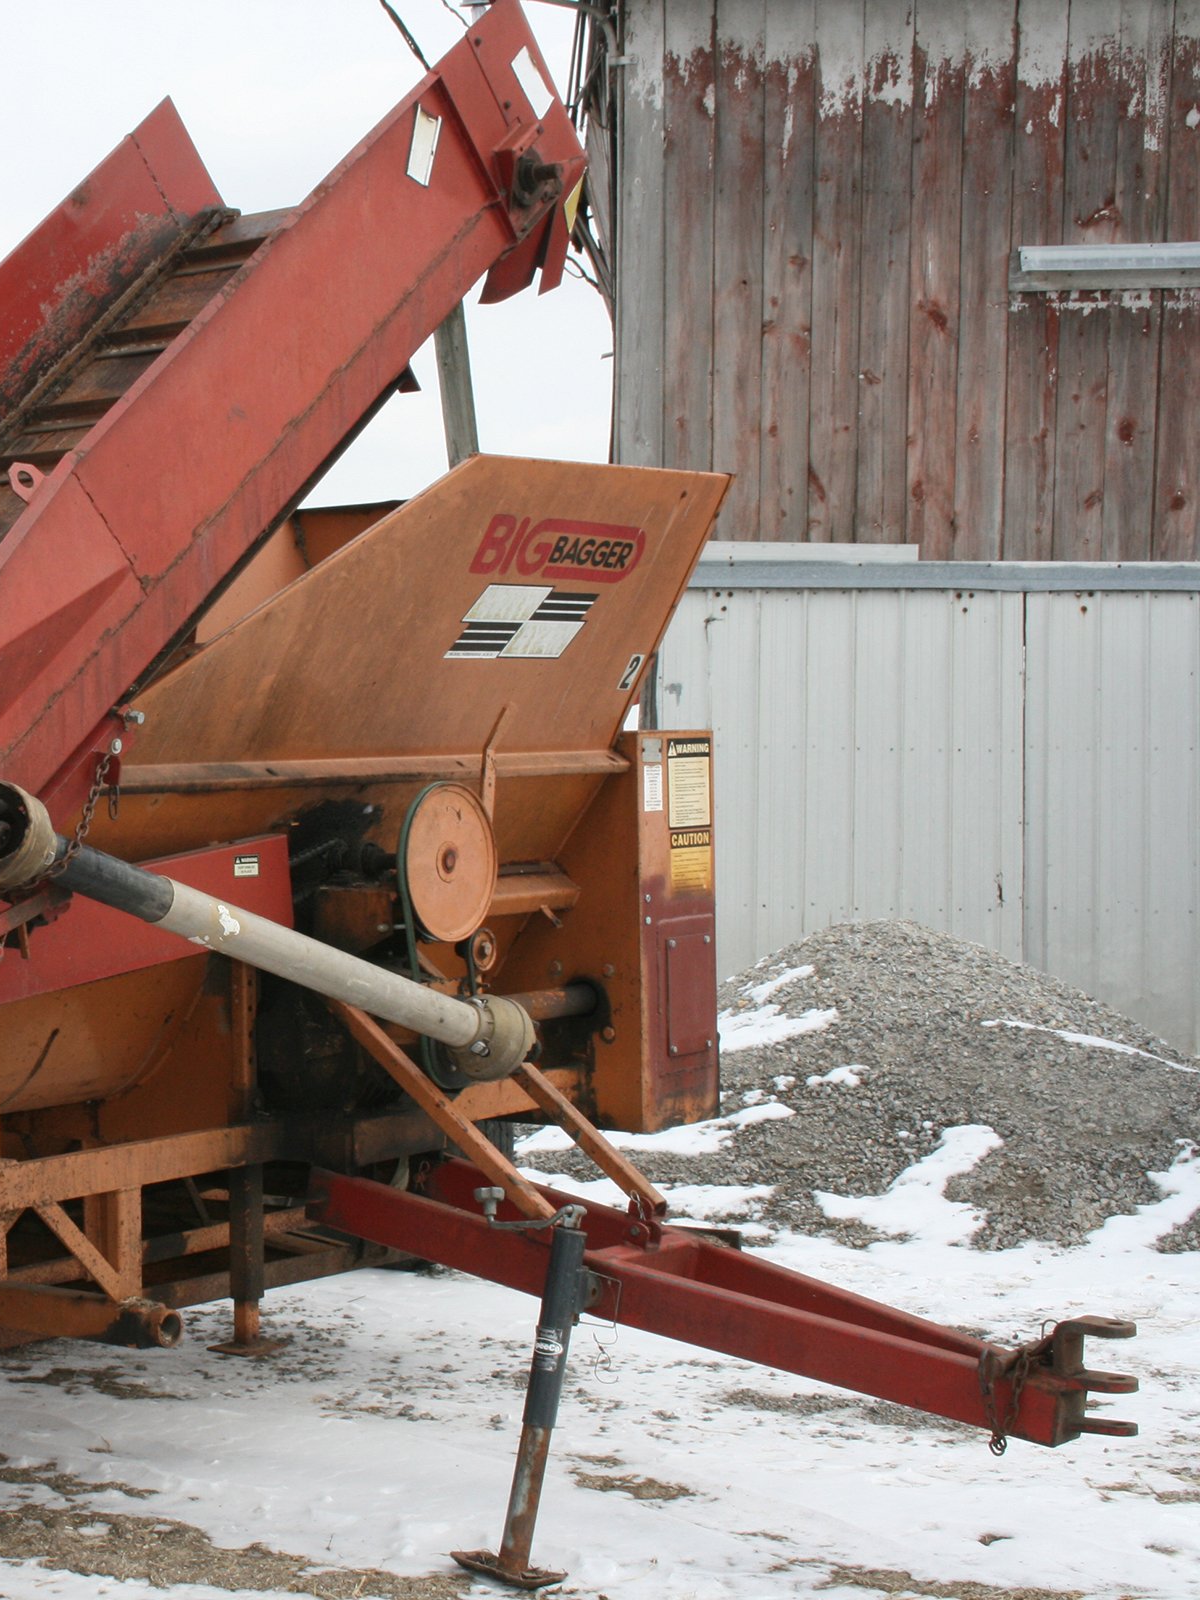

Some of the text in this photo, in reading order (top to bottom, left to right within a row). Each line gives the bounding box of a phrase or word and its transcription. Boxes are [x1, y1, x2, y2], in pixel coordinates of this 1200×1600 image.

[469, 513, 634, 576] BIG BAGGER
[620, 656, 641, 689] 2
[676, 743, 709, 754] WARNING
[671, 832, 710, 847] CAUTION
